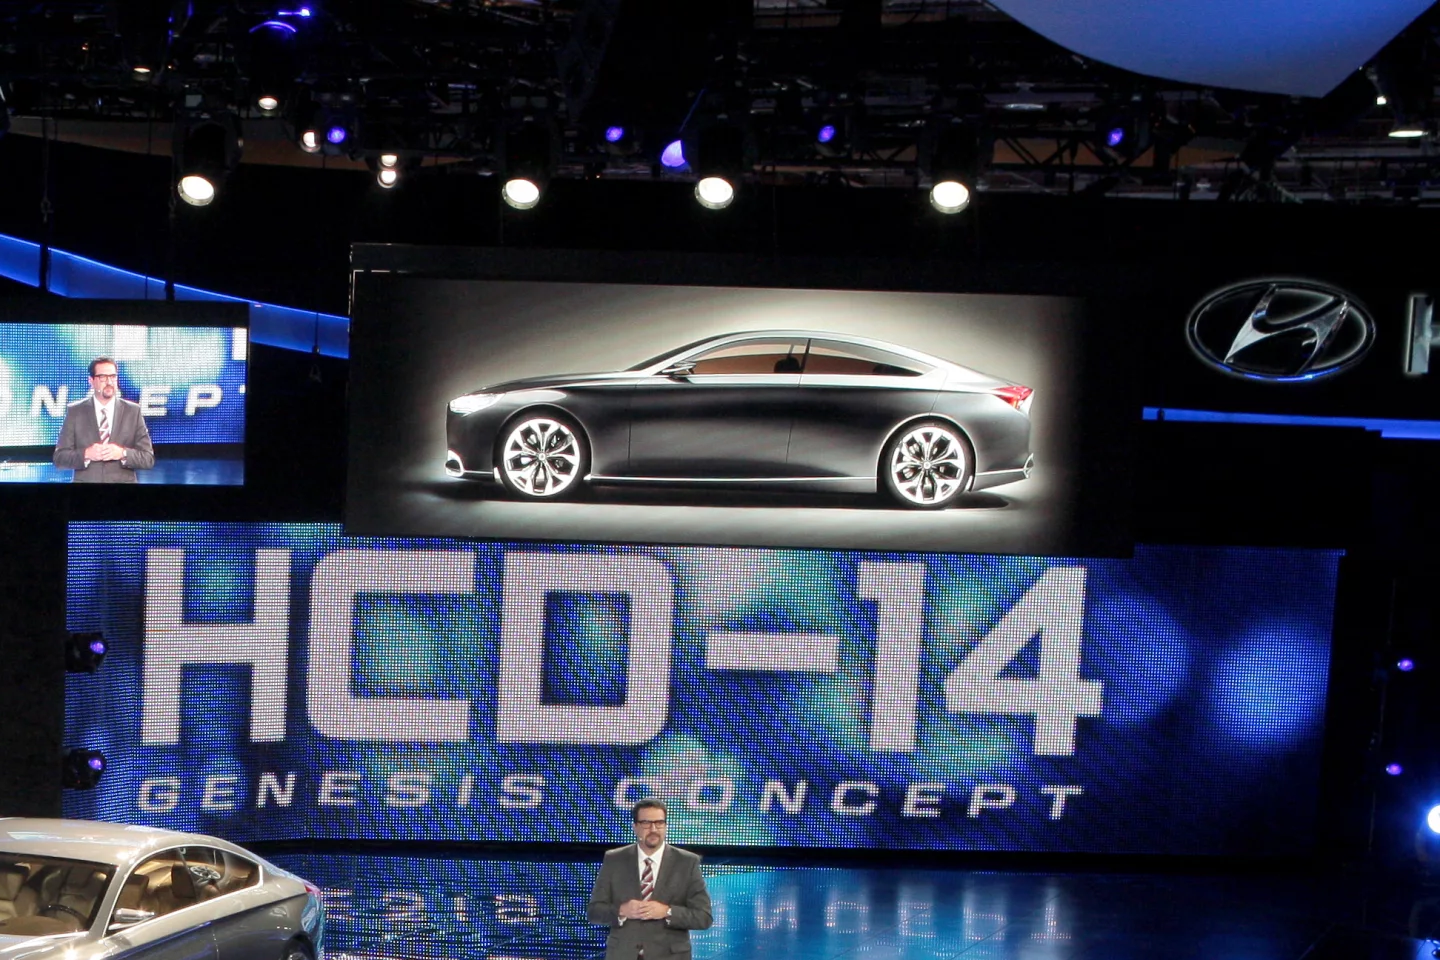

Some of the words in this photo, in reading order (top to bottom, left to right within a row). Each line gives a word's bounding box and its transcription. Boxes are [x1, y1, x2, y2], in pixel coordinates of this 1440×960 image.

[141, 547, 1104, 756] HCD-14
[137, 770, 546, 813] GENESIS
[615, 774, 1083, 820] CONCEPT
